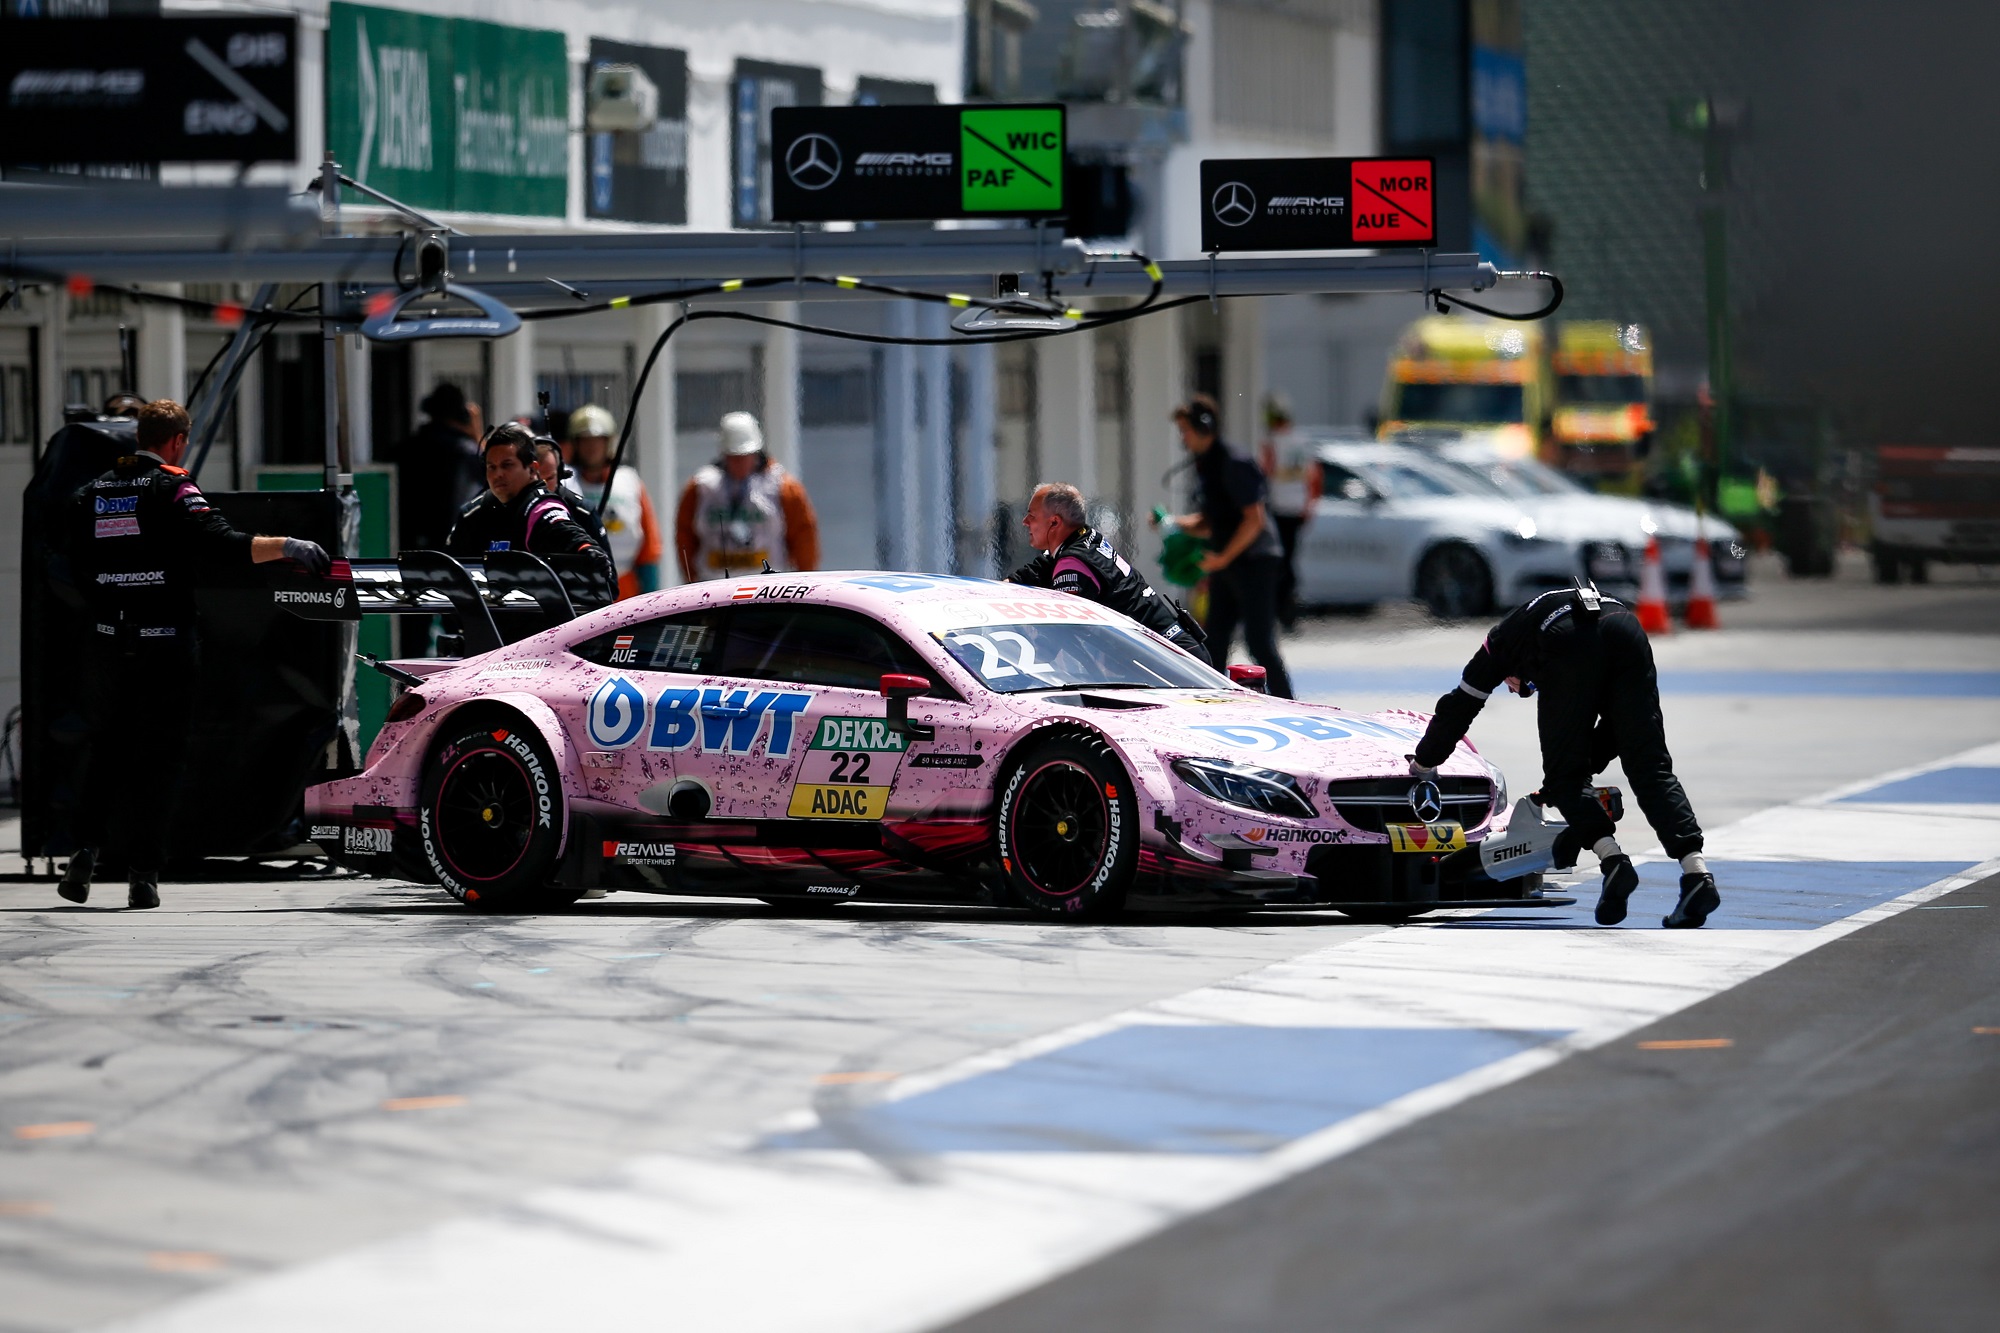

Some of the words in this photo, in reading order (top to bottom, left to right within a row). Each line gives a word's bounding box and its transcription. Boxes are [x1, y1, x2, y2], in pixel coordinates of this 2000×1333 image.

[1007, 132, 1057, 150] WIC
[888, 153, 953, 165] AMG
[855, 167, 953, 176] MOTORSPORT
[966, 169, 1015, 188] PAF
[1379, 177, 1428, 192] MOR
[1293, 196, 1344, 207] AMG
[1267, 207, 1344, 215] MOTORSPORT
[1355, 213, 1400, 229] AUE
[107, 495, 138, 513] BWT
[274, 591, 332, 604] PETRONAS
[754, 585, 810, 600] AUER
[988, 602, 1109, 622] BOSCH
[608, 649, 638, 663] AUE
[951, 631, 1055, 680] 22
[484, 660, 545, 673] MAGNESIUM
[648, 687, 815, 757] BWT
[821, 719, 903, 749] DEKRA
[828, 751, 871, 784] 22
[811, 788, 868, 816] ADAC
[614, 843, 676, 857] REMUS
[1493, 842, 1532, 863] STIHL
[806, 885, 849, 894] PETRONAS
